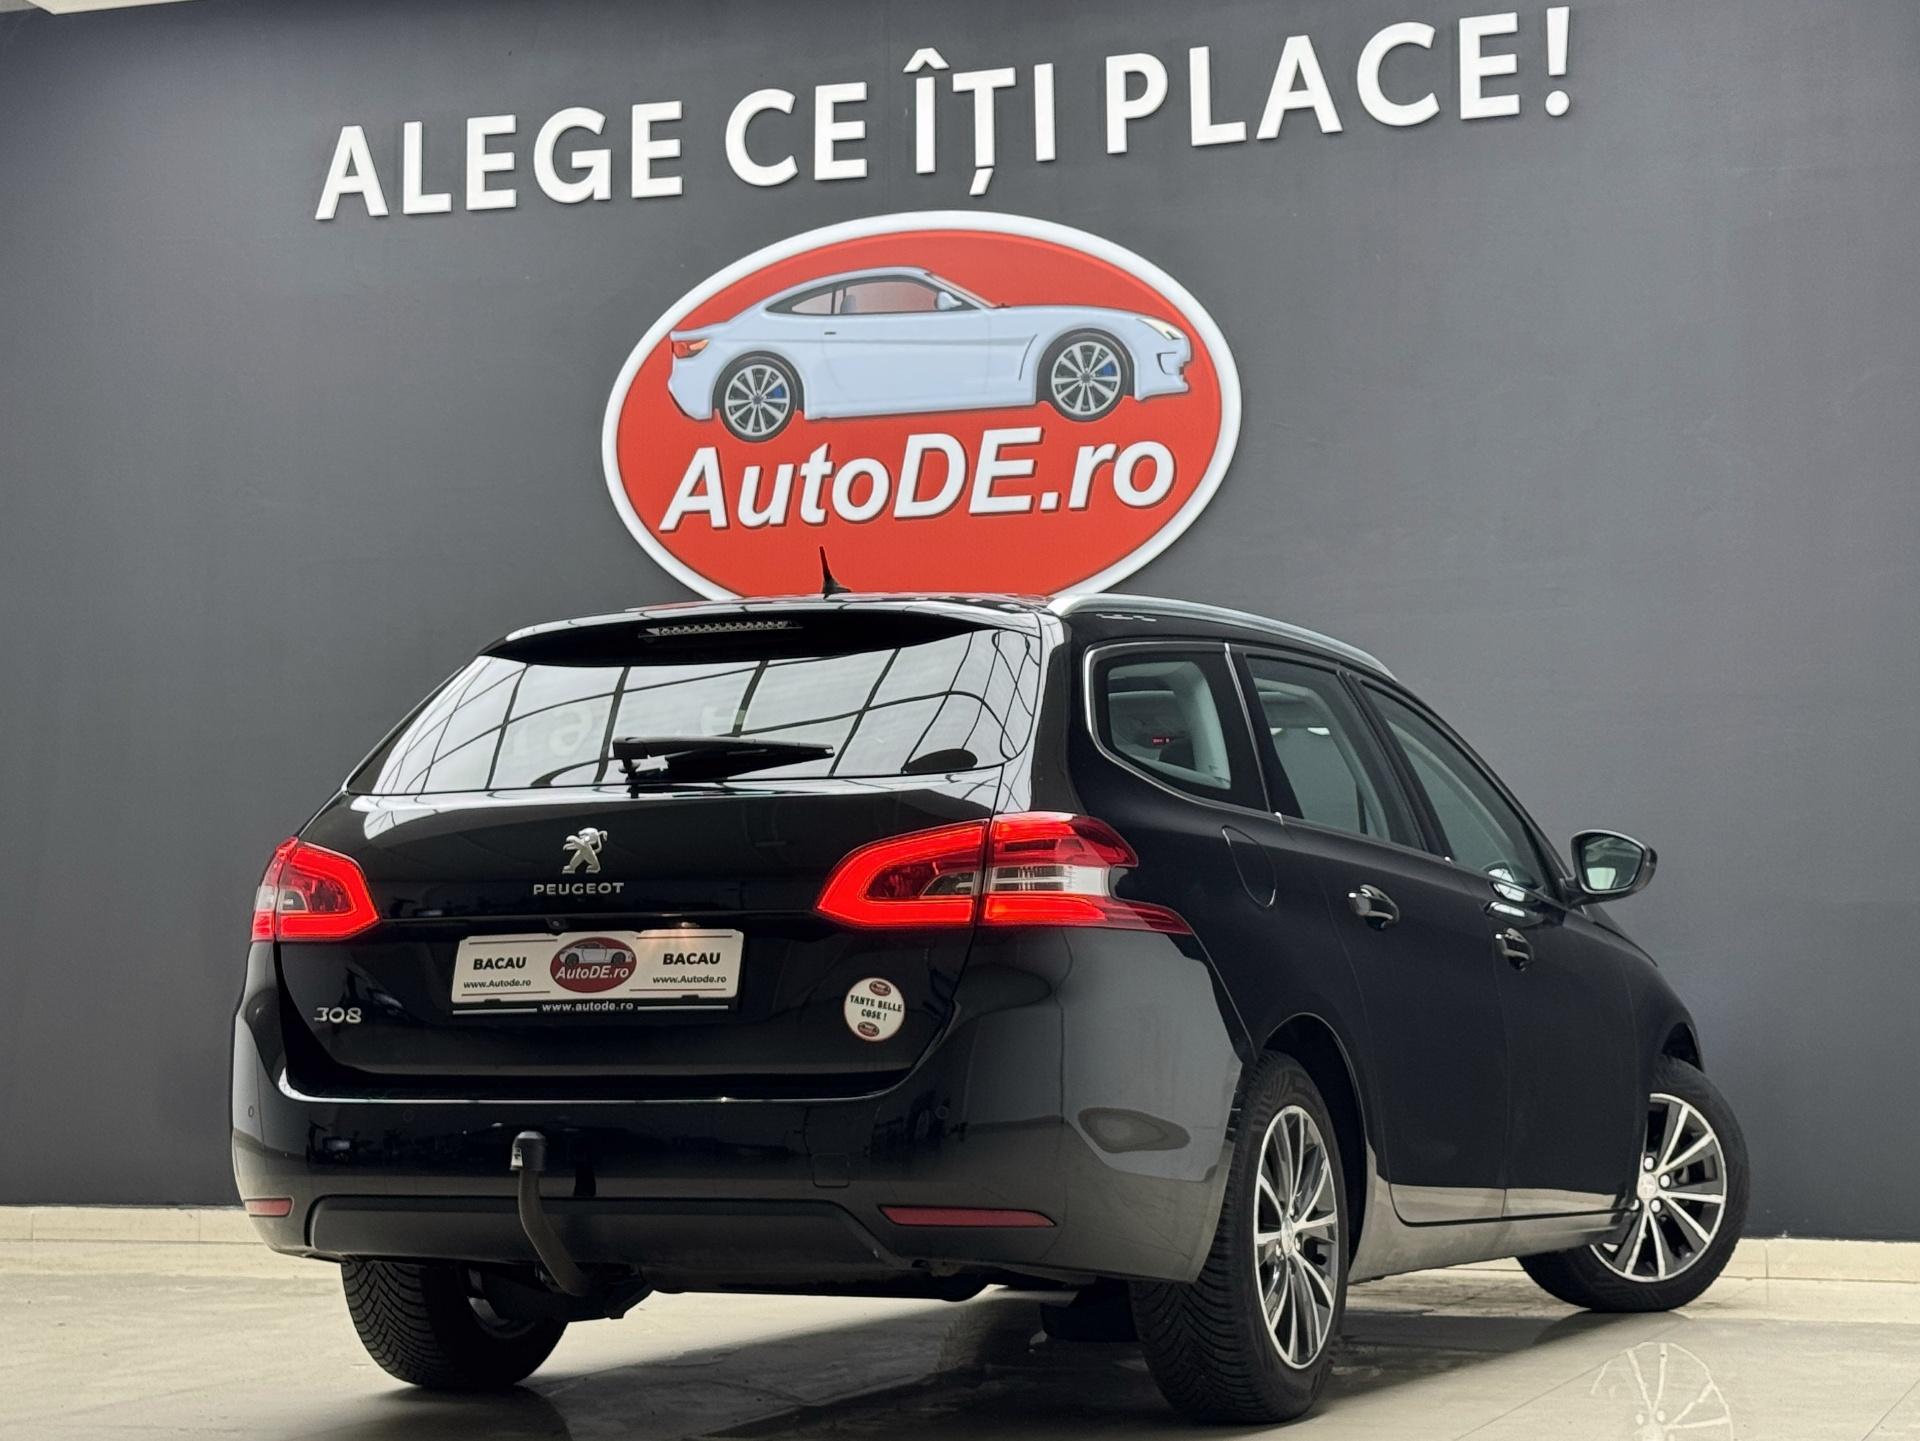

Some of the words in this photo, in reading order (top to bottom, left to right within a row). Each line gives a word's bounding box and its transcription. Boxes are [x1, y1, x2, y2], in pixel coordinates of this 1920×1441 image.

[314, 100, 684, 222] ALEGE
[724, 81, 868, 188] CE
[1106, 6, 1571, 155] PLACE!
[658, 426, 1176, 533] AutoDE.ro
[533, 882, 625, 896] PEUGEOT
[472, 957, 527, 971] BACAU
[662, 952, 721, 966] BACAU
[555, 965, 629, 981] AutoDE.ro
[652, 974, 727, 985] www.Autode.ro
[463, 979, 532, 989] www.Autode.ro
[542, 1002, 634, 1012] www.autode.ro
[850, 995, 875, 1007] TANTE
[878, 1000, 902, 1012] BELLE
[314, 1007, 362, 1024] 308
[861, 1009, 881, 1020] COSE
